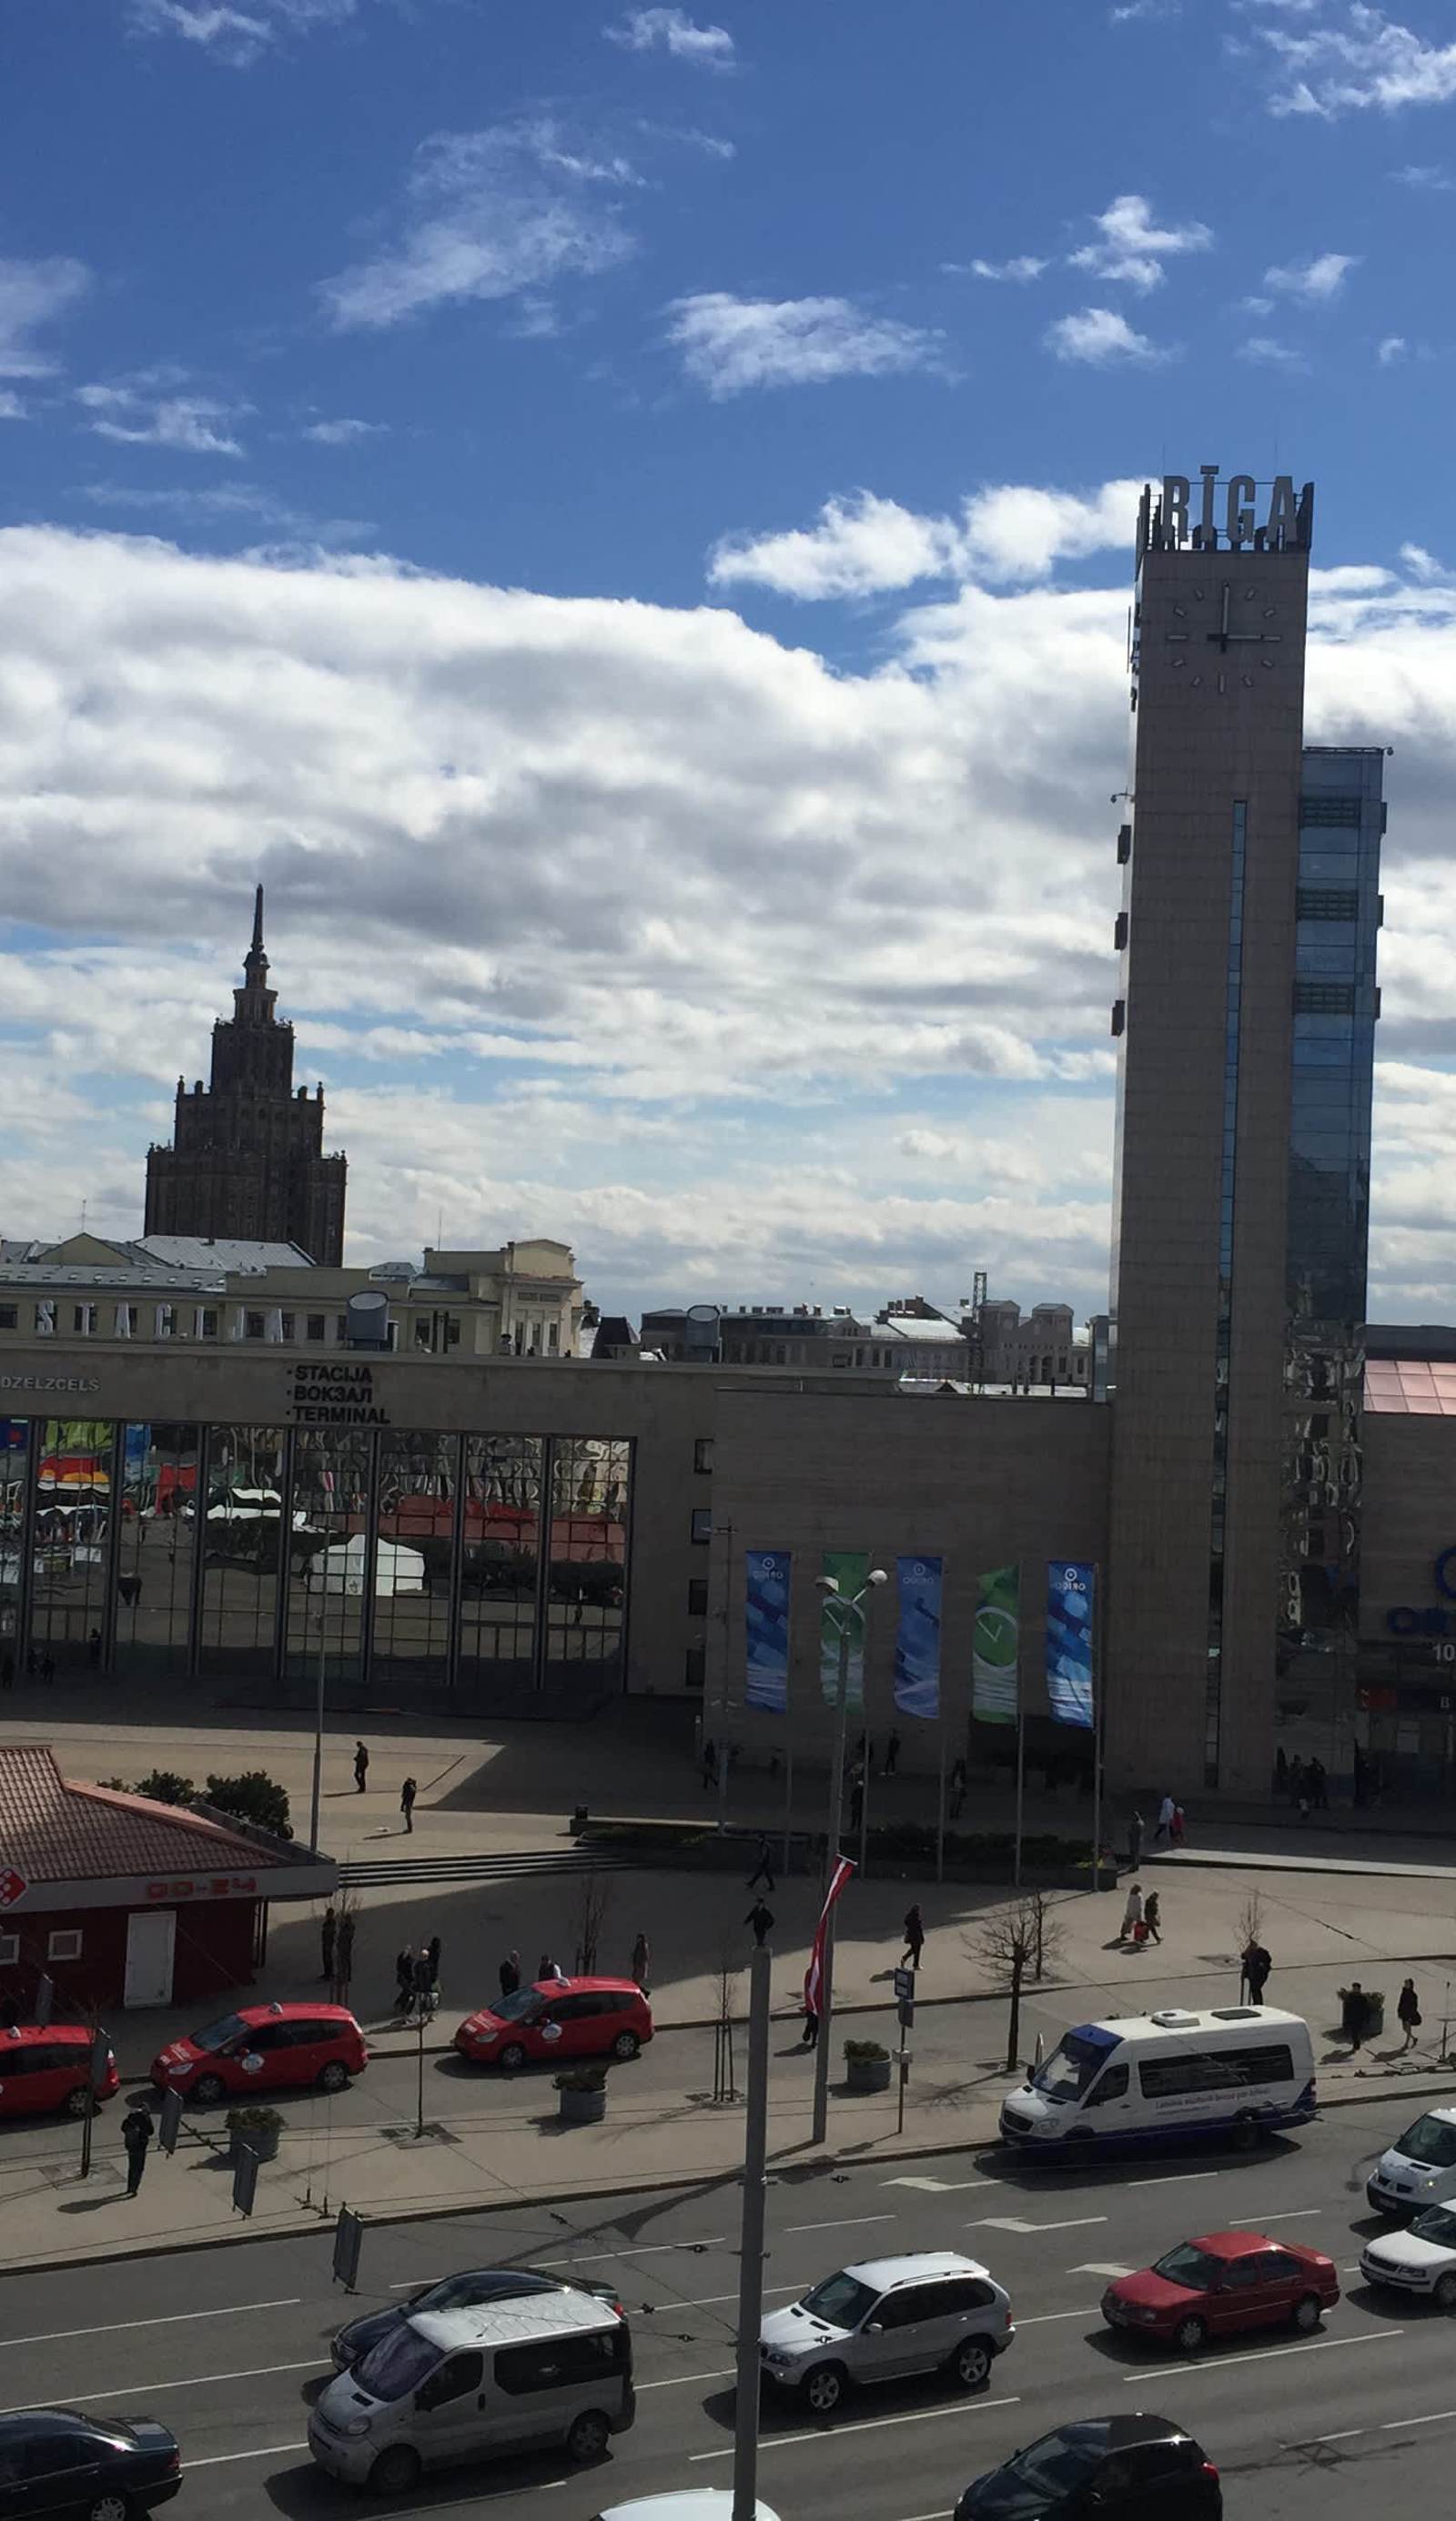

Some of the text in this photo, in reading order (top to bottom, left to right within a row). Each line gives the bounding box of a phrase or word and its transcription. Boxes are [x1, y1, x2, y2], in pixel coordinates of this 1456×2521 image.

[294, 1365, 372, 1382] STACIJA
[294, 1385, 372, 1402] ВОКЗАЛ
[291, 1405, 391, 1424] TERMINAL
